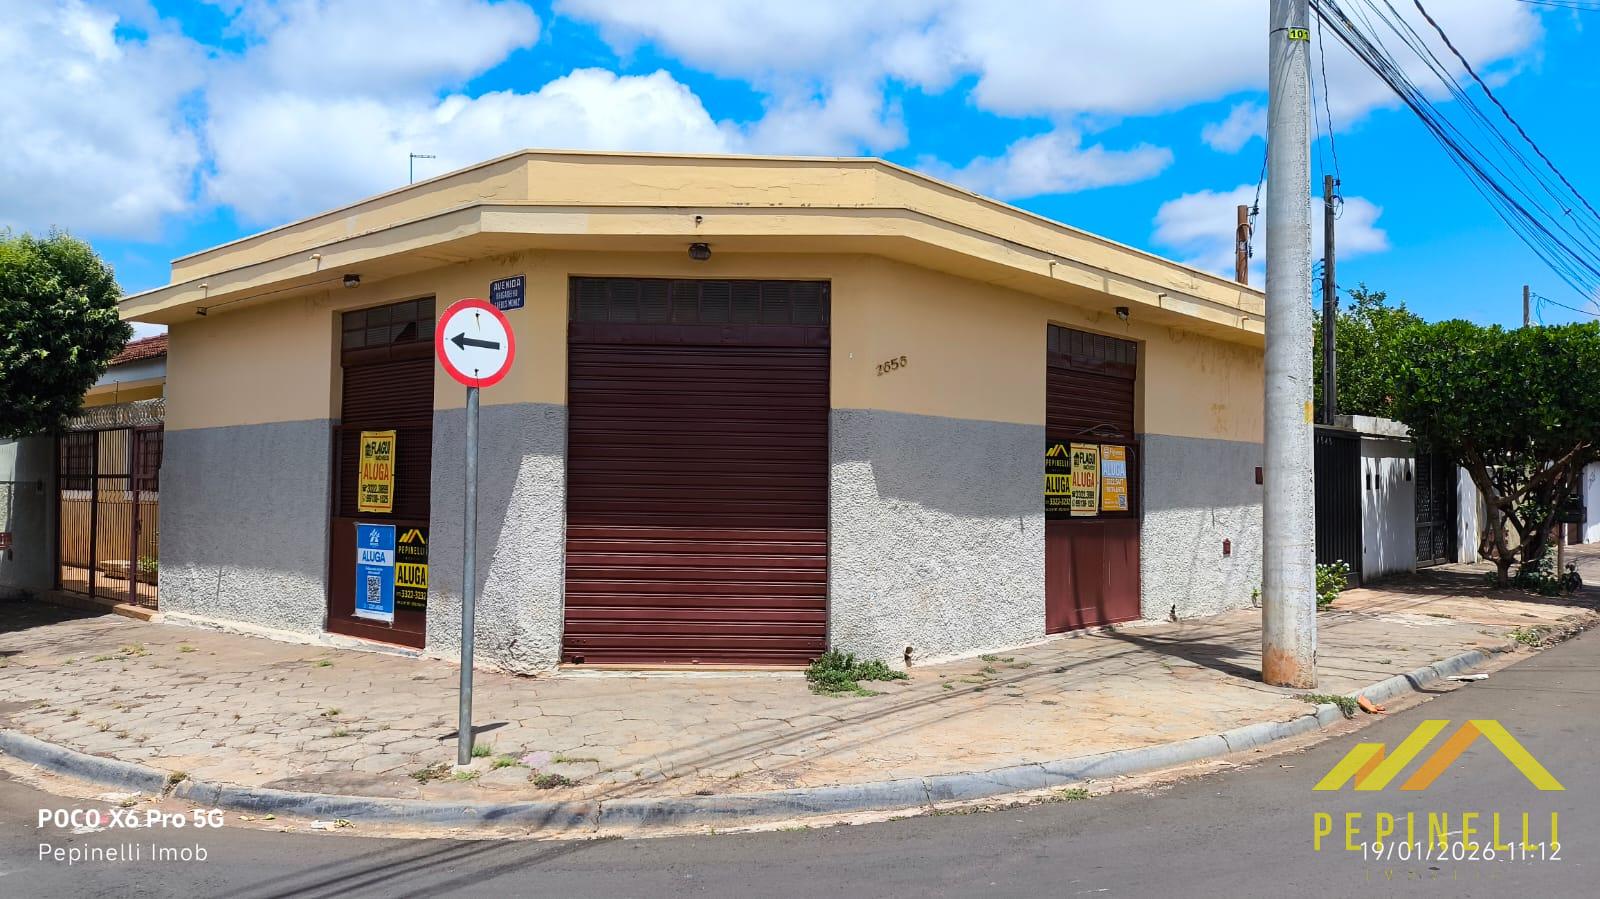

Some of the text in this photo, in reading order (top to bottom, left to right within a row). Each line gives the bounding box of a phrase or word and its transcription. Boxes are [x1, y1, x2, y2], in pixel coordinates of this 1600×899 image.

[493, 279, 520, 290] AVENIDA
[363, 463, 390, 480] ALUGA
[1103, 461, 1125, 476] ALUGA
[1046, 476, 1070, 493] ALUGA
[1072, 471, 1094, 487] ALUGA
[362, 550, 385, 563] ALUGA
[398, 545, 428, 556] PEPINELLI
[397, 565, 426, 585] ALUGA
